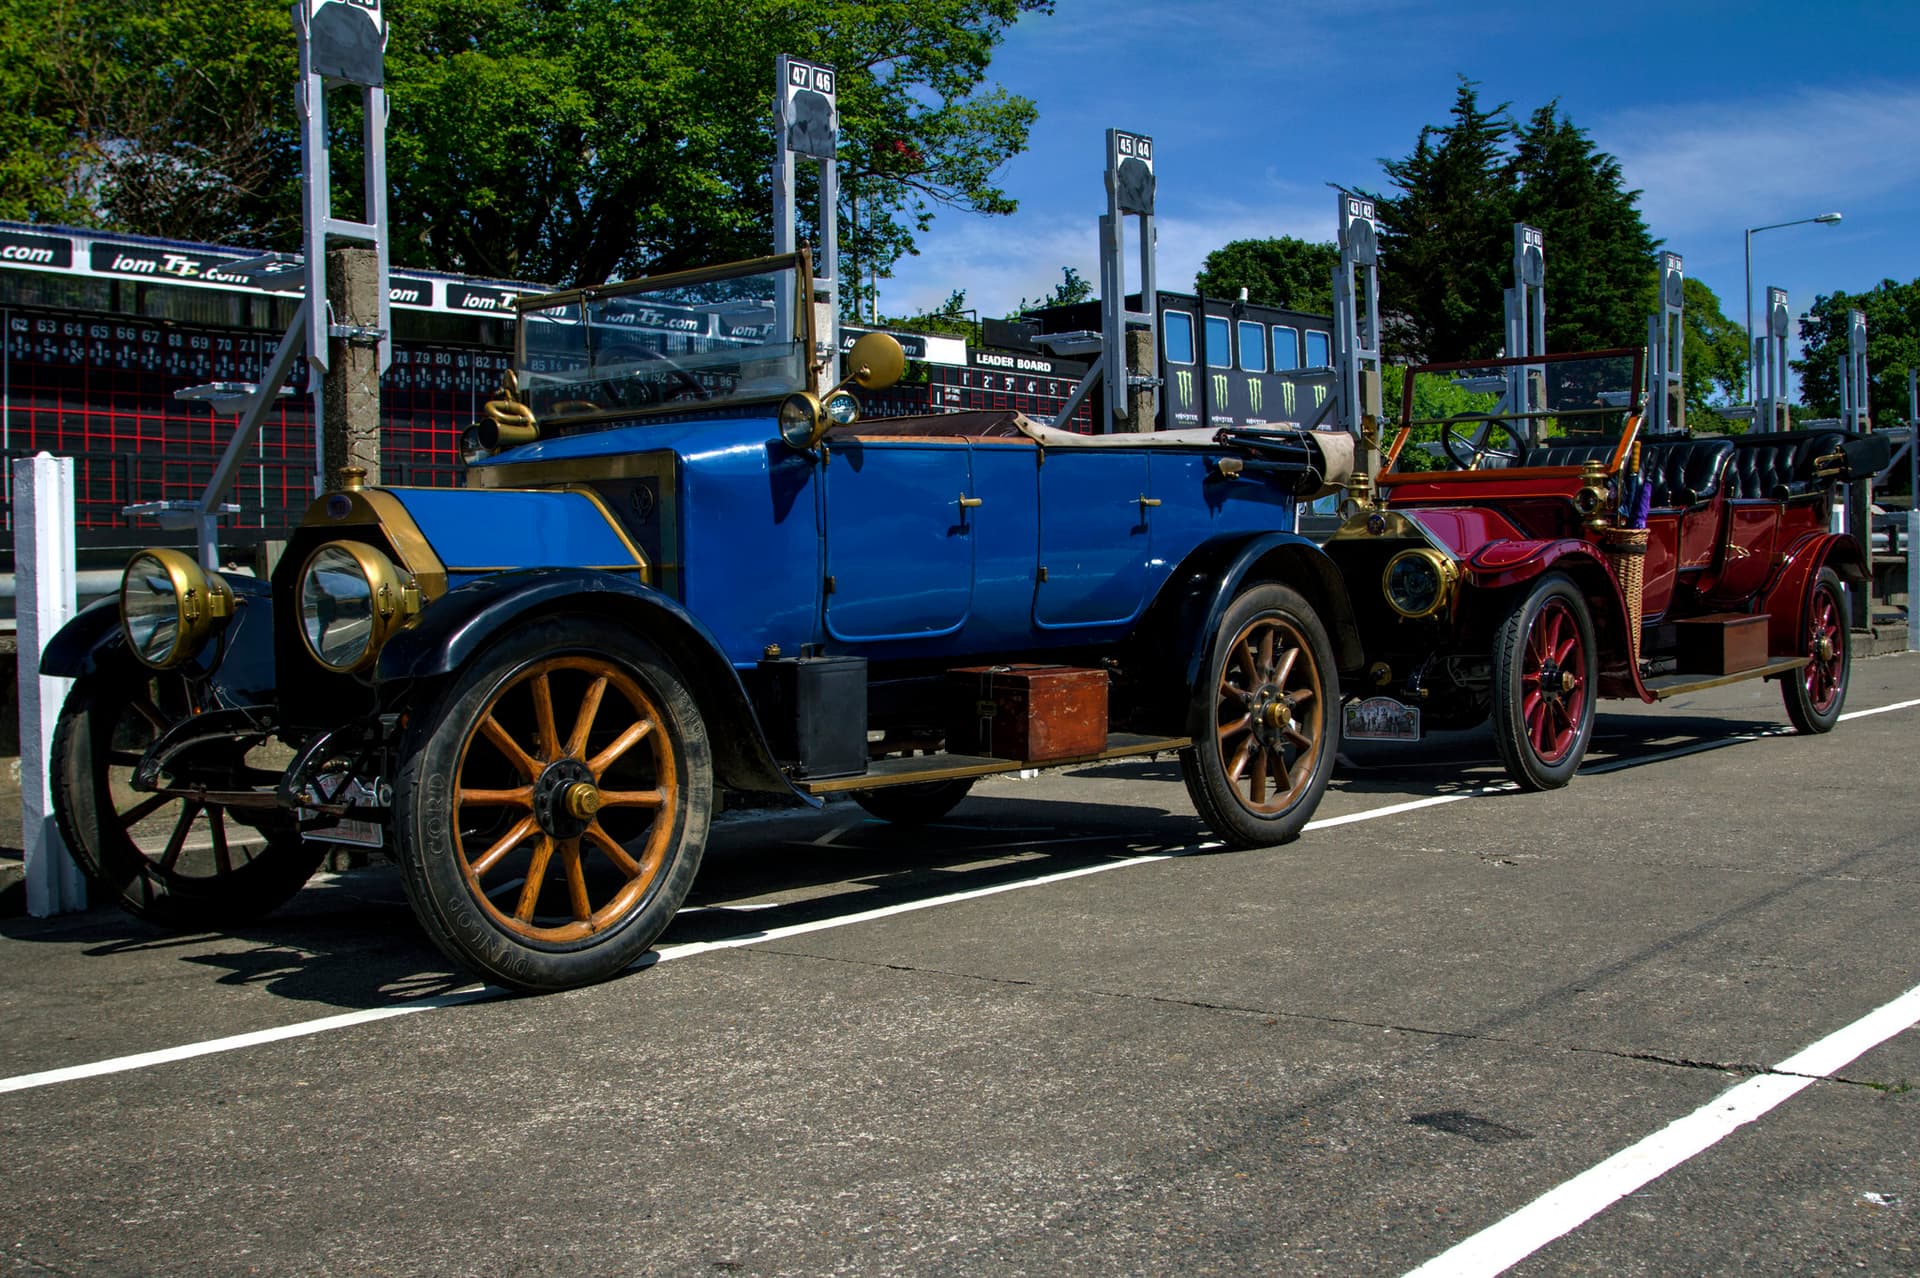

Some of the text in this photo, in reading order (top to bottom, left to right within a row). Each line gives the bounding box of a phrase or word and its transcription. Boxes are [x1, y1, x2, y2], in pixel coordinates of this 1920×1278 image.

[793, 66, 830, 92] 47 46
[1120, 138, 1149, 158] 45 44
[11, 317, 29, 332] 62
[37, 319, 57, 334] 63
[63, 322, 83, 337] 64
[90, 325, 109, 339] 65
[116, 326, 136, 340] 66
[142, 330, 160, 344] 67
[191, 336, 209, 350] 69
[216, 338, 232, 351] 70
[240, 339, 256, 352] 71
[415, 352, 431, 364] 79
[435, 353, 452, 365] 80
[475, 356, 491, 368] 82
[976, 353, 1052, 372] LEADER BOARD
[427, 773, 448, 856] CORD
[450, 897, 530, 976] DUNLOP
